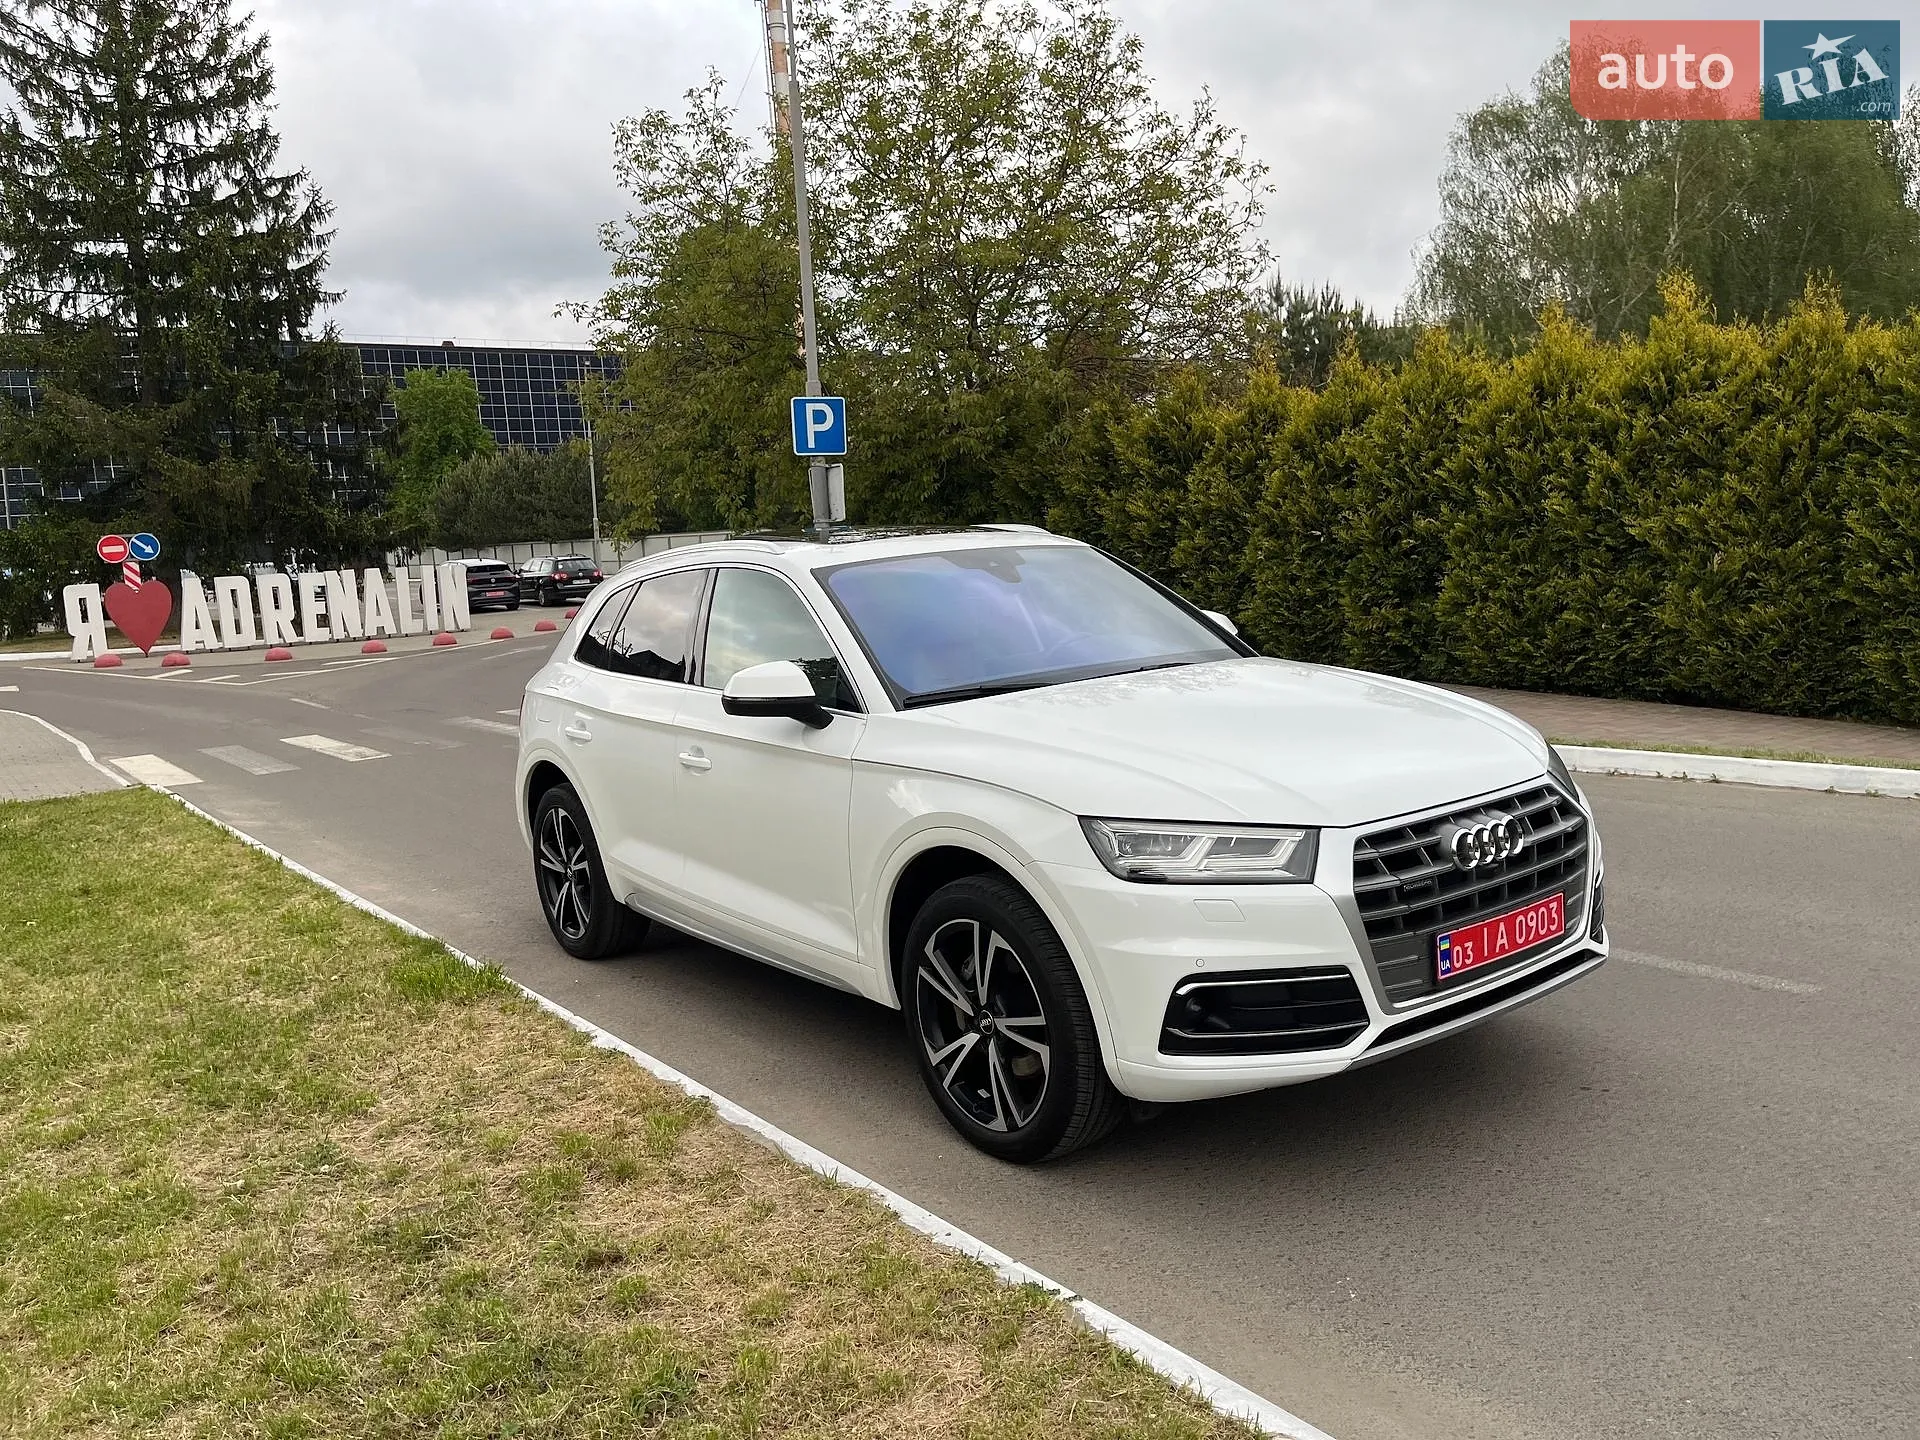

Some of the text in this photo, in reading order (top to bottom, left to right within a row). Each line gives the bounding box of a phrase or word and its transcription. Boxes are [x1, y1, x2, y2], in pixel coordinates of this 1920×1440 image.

[805, 402, 834, 449] P
[63, 583, 107, 660] Я
[180, 567, 471, 651] ADRENALIN
[1441, 959, 1450, 970] UA
[1453, 941, 1473, 968] 03
[1515, 901, 1558, 944] 0903
